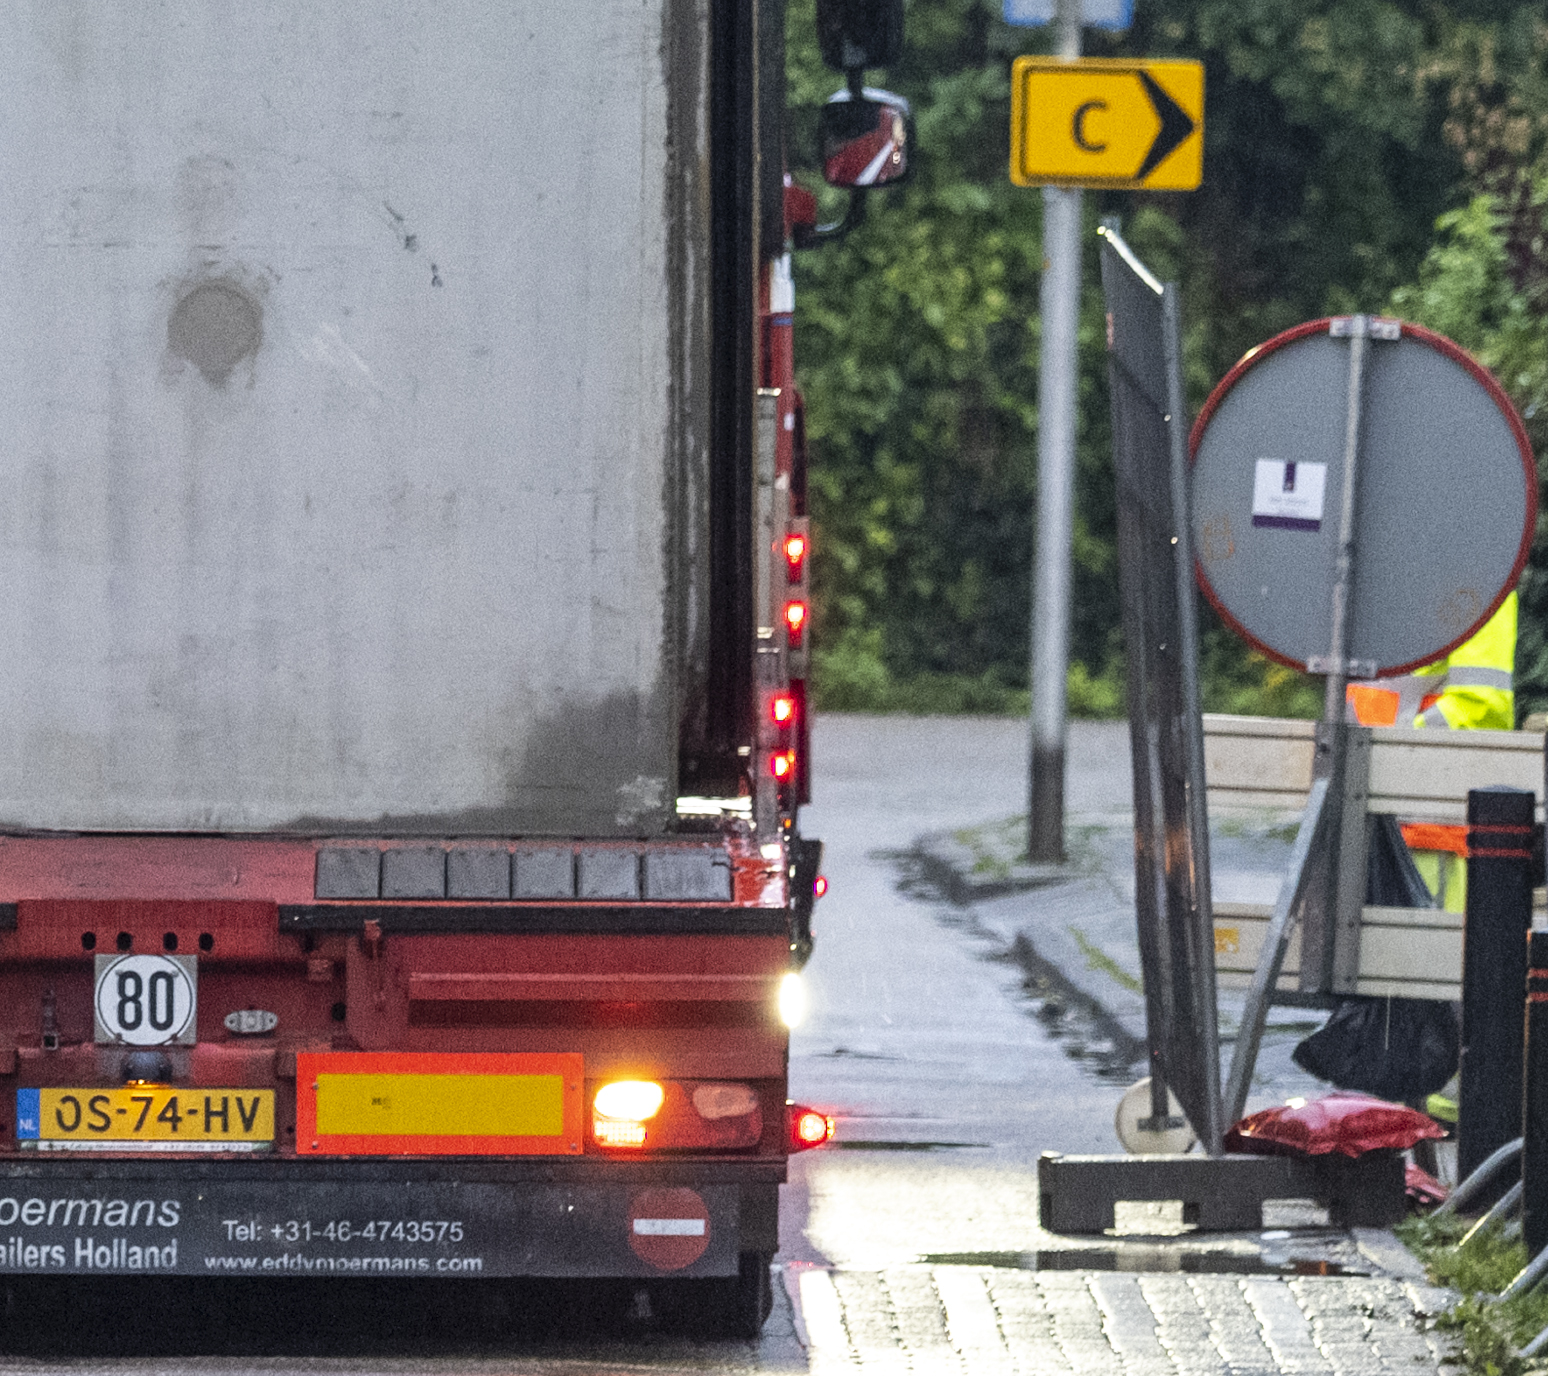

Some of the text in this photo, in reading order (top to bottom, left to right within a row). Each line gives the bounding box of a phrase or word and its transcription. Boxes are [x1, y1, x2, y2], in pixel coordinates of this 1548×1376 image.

[1070, 98, 1109, 154] C
[117, 970, 175, 1031] 80
[19, 1118, 37, 1131] NL
[55, 1094, 261, 1133] OS-74-HV
[223, 1220, 464, 1243] Tel: +31-46-4743575
[73, 1237, 178, 1270] Holland
